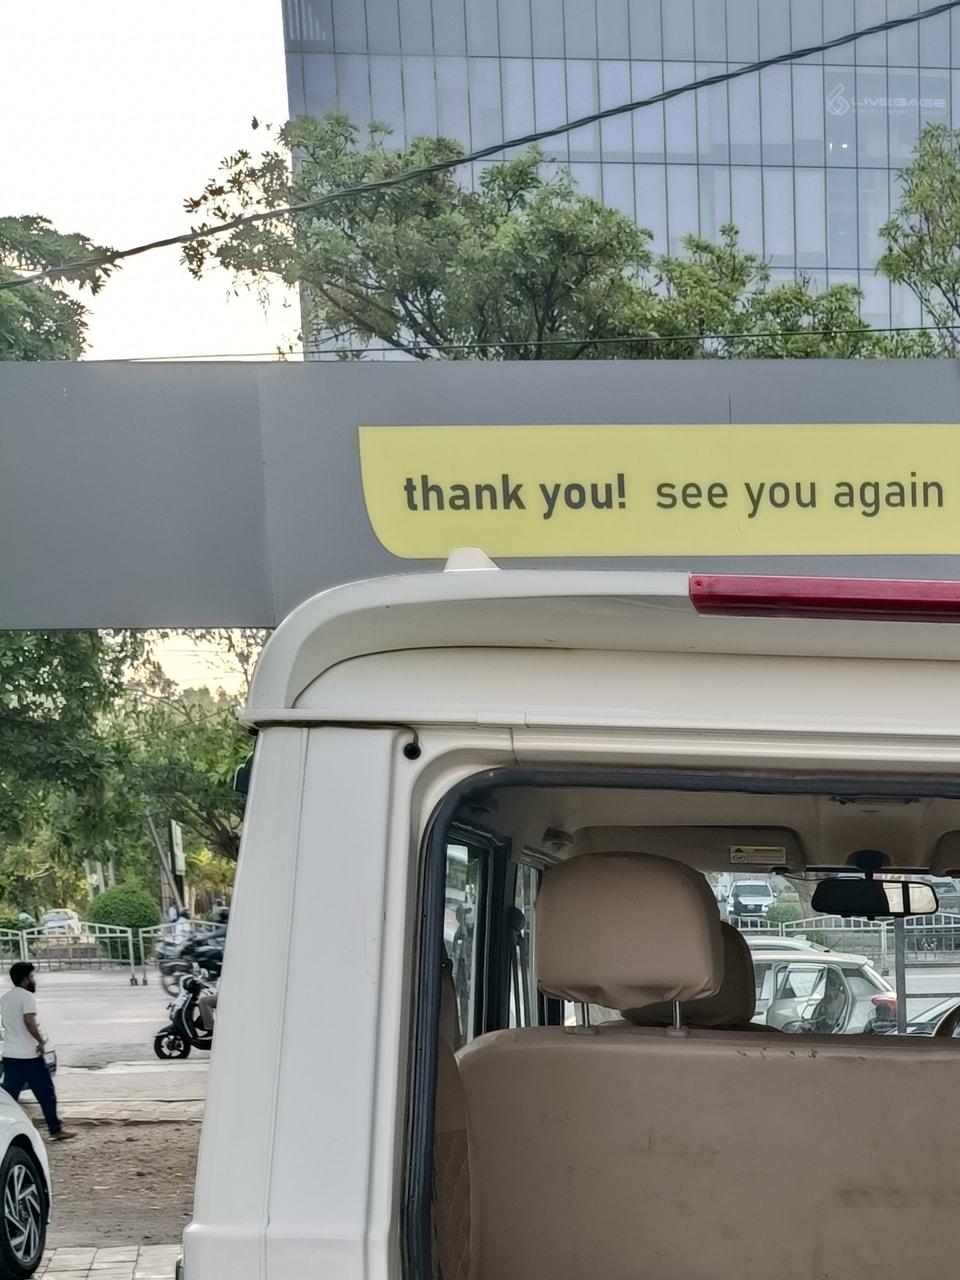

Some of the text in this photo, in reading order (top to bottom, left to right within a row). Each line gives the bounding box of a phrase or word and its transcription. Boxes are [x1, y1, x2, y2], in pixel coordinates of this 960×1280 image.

[404, 472, 944, 520] thank you! see you again
